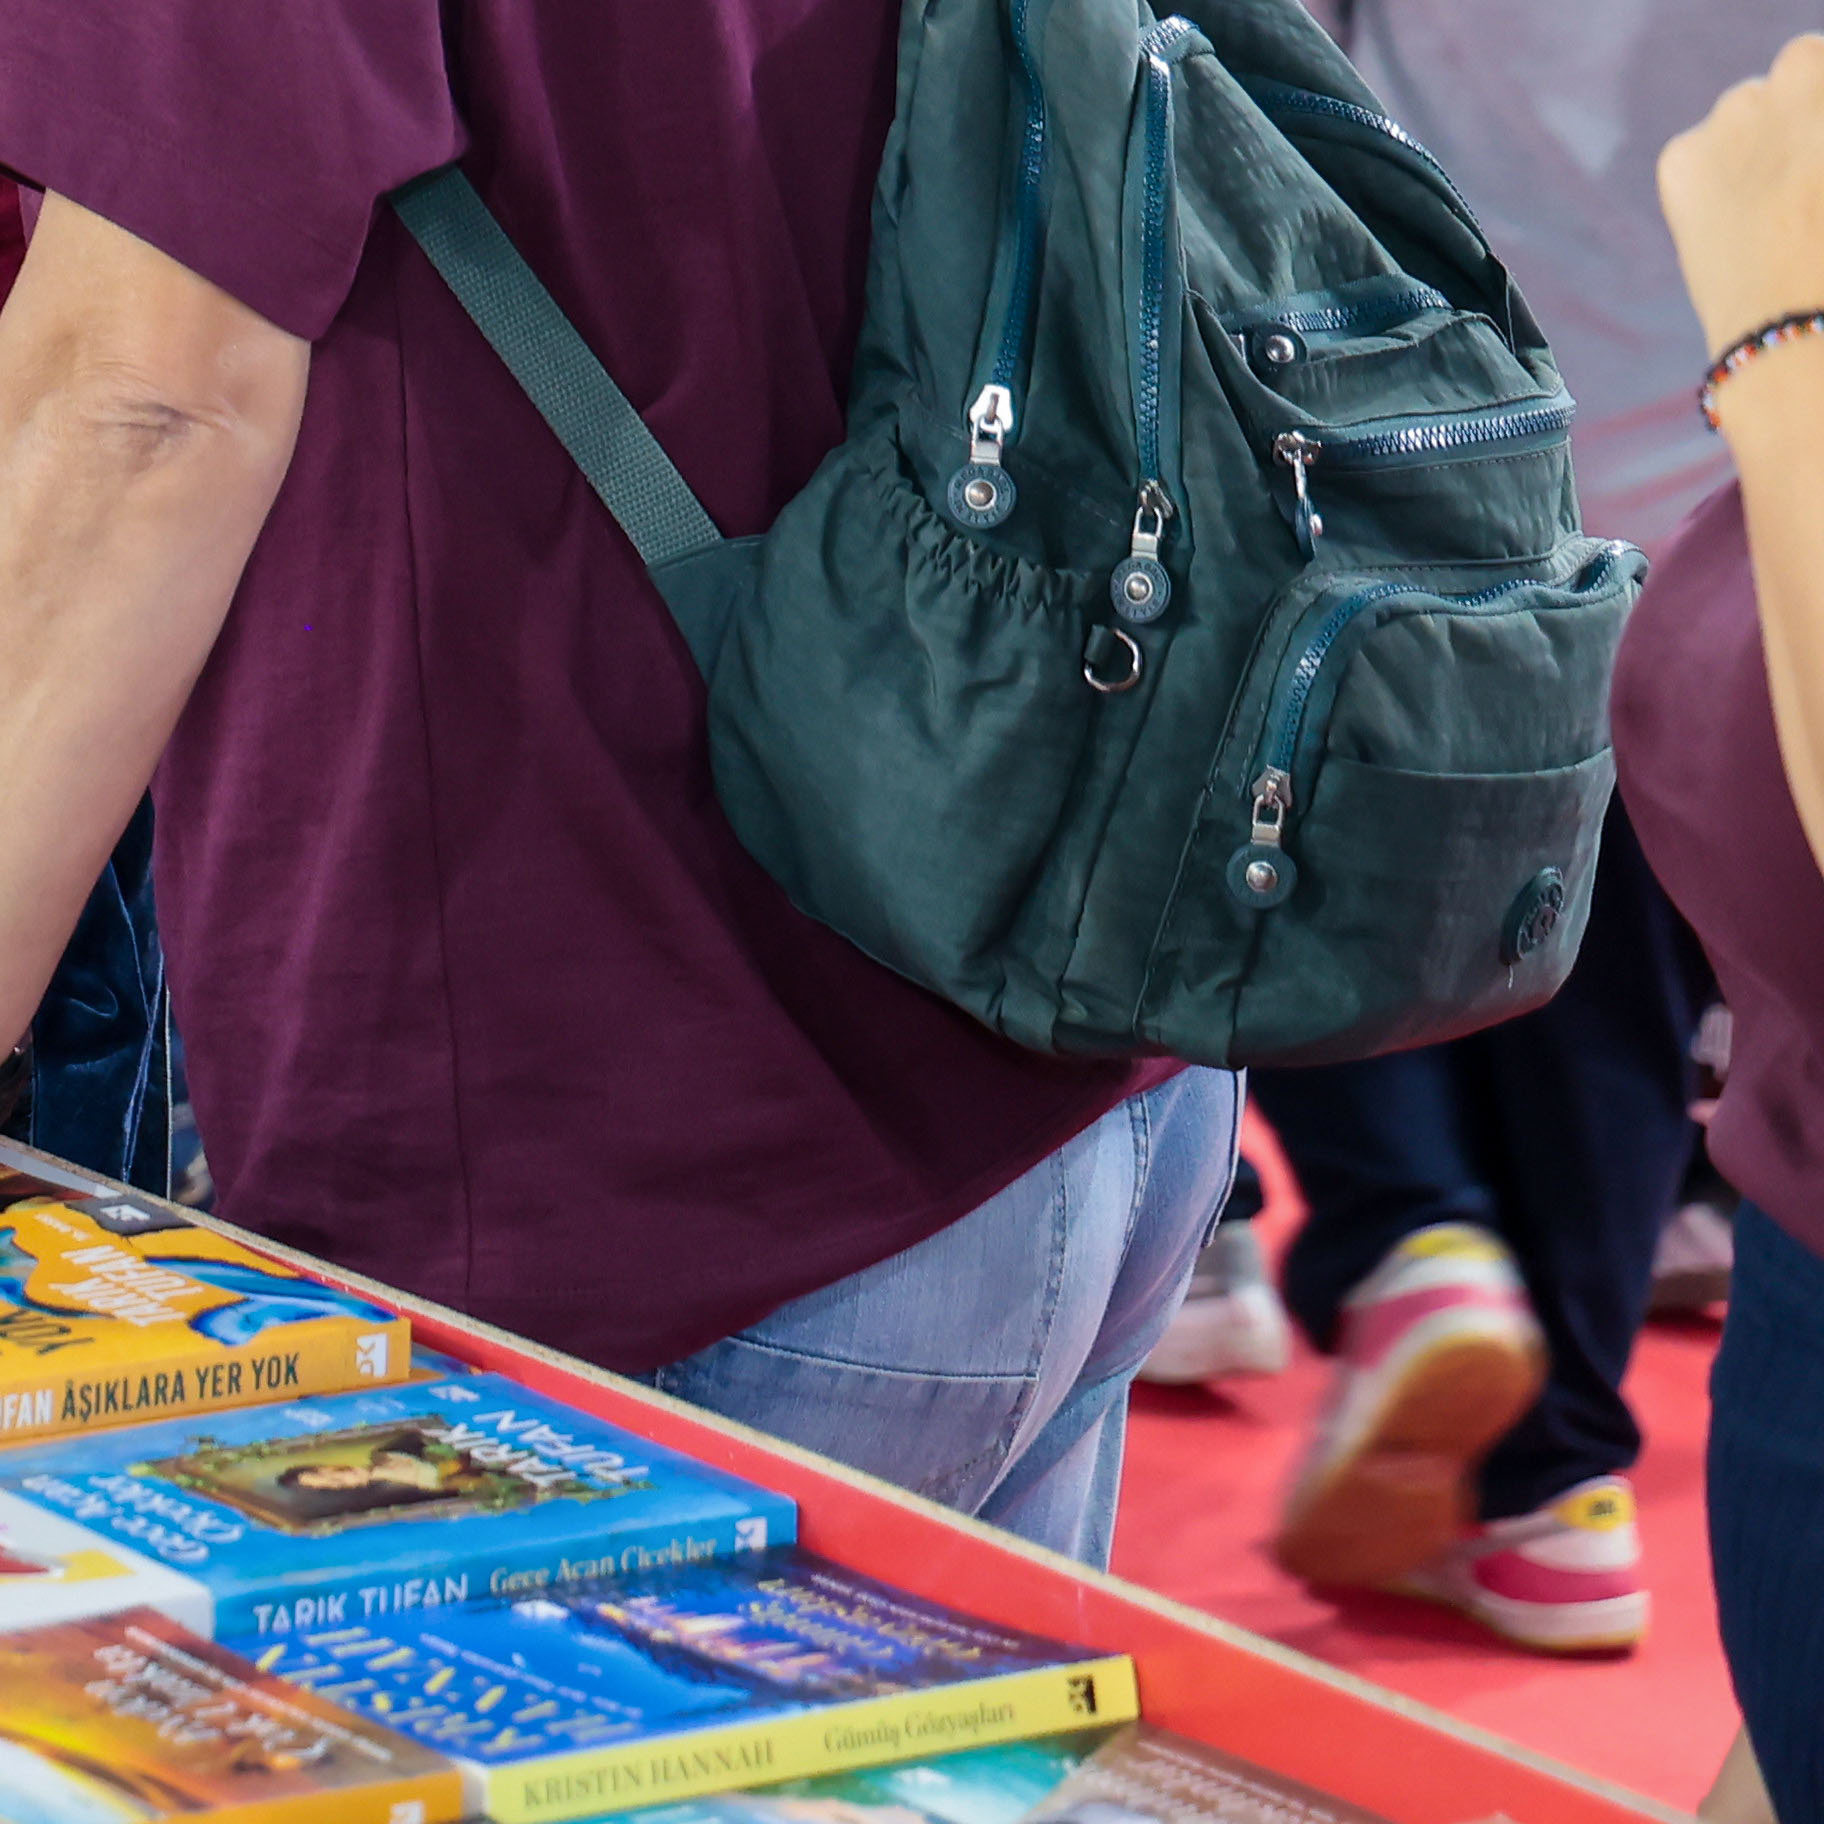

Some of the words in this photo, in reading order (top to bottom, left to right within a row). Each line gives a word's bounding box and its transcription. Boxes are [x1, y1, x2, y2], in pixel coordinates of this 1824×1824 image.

[47, 1276, 188, 1327] TARIK
[59, 1244, 204, 1303] TUFAN
[194, 1360, 244, 1399] YER
[250, 1351, 301, 1391] YOK
[417, 1422, 577, 1490] TARIK
[472, 1410, 650, 1482] TUFAN
[253, 1593, 348, 1633] TARIK
[358, 1572, 469, 1622] TUFAN
[490, 1566, 550, 1598] Gece
[522, 1762, 644, 1810] KRISTIN
[650, 1736, 776, 1789] HANNAH
[823, 1723, 902, 1756] Gümüş
